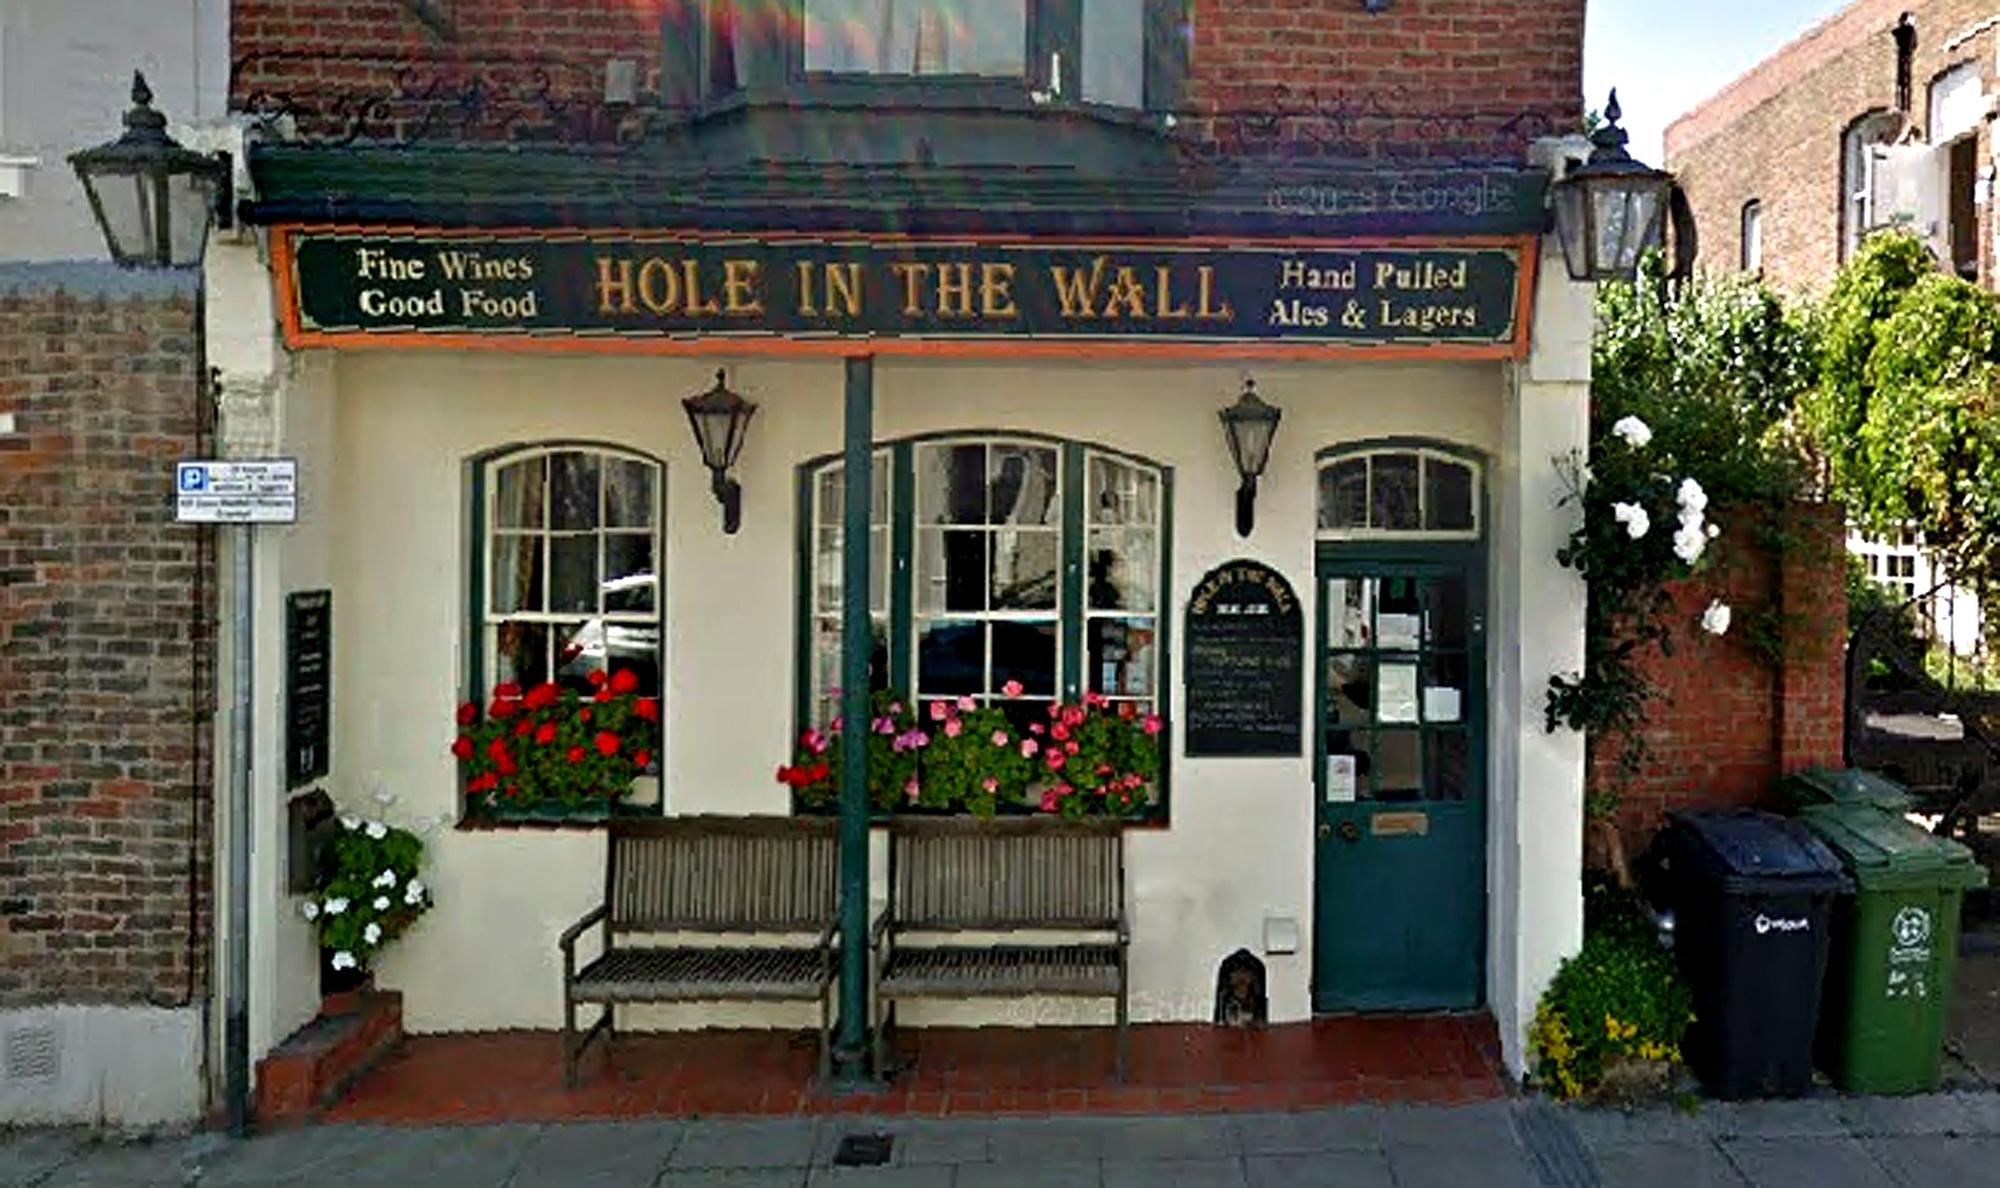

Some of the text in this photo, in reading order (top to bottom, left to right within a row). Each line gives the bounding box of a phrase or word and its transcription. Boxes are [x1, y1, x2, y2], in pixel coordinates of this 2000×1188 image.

[357, 248, 534, 281] Fine Wines
[1280, 258, 1468, 291] Hand Pulled
[358, 289, 538, 319] Good Food
[596, 254, 1235, 323] HOLE IN THE WALL
[1268, 297, 1477, 333] Ales & Lagers
